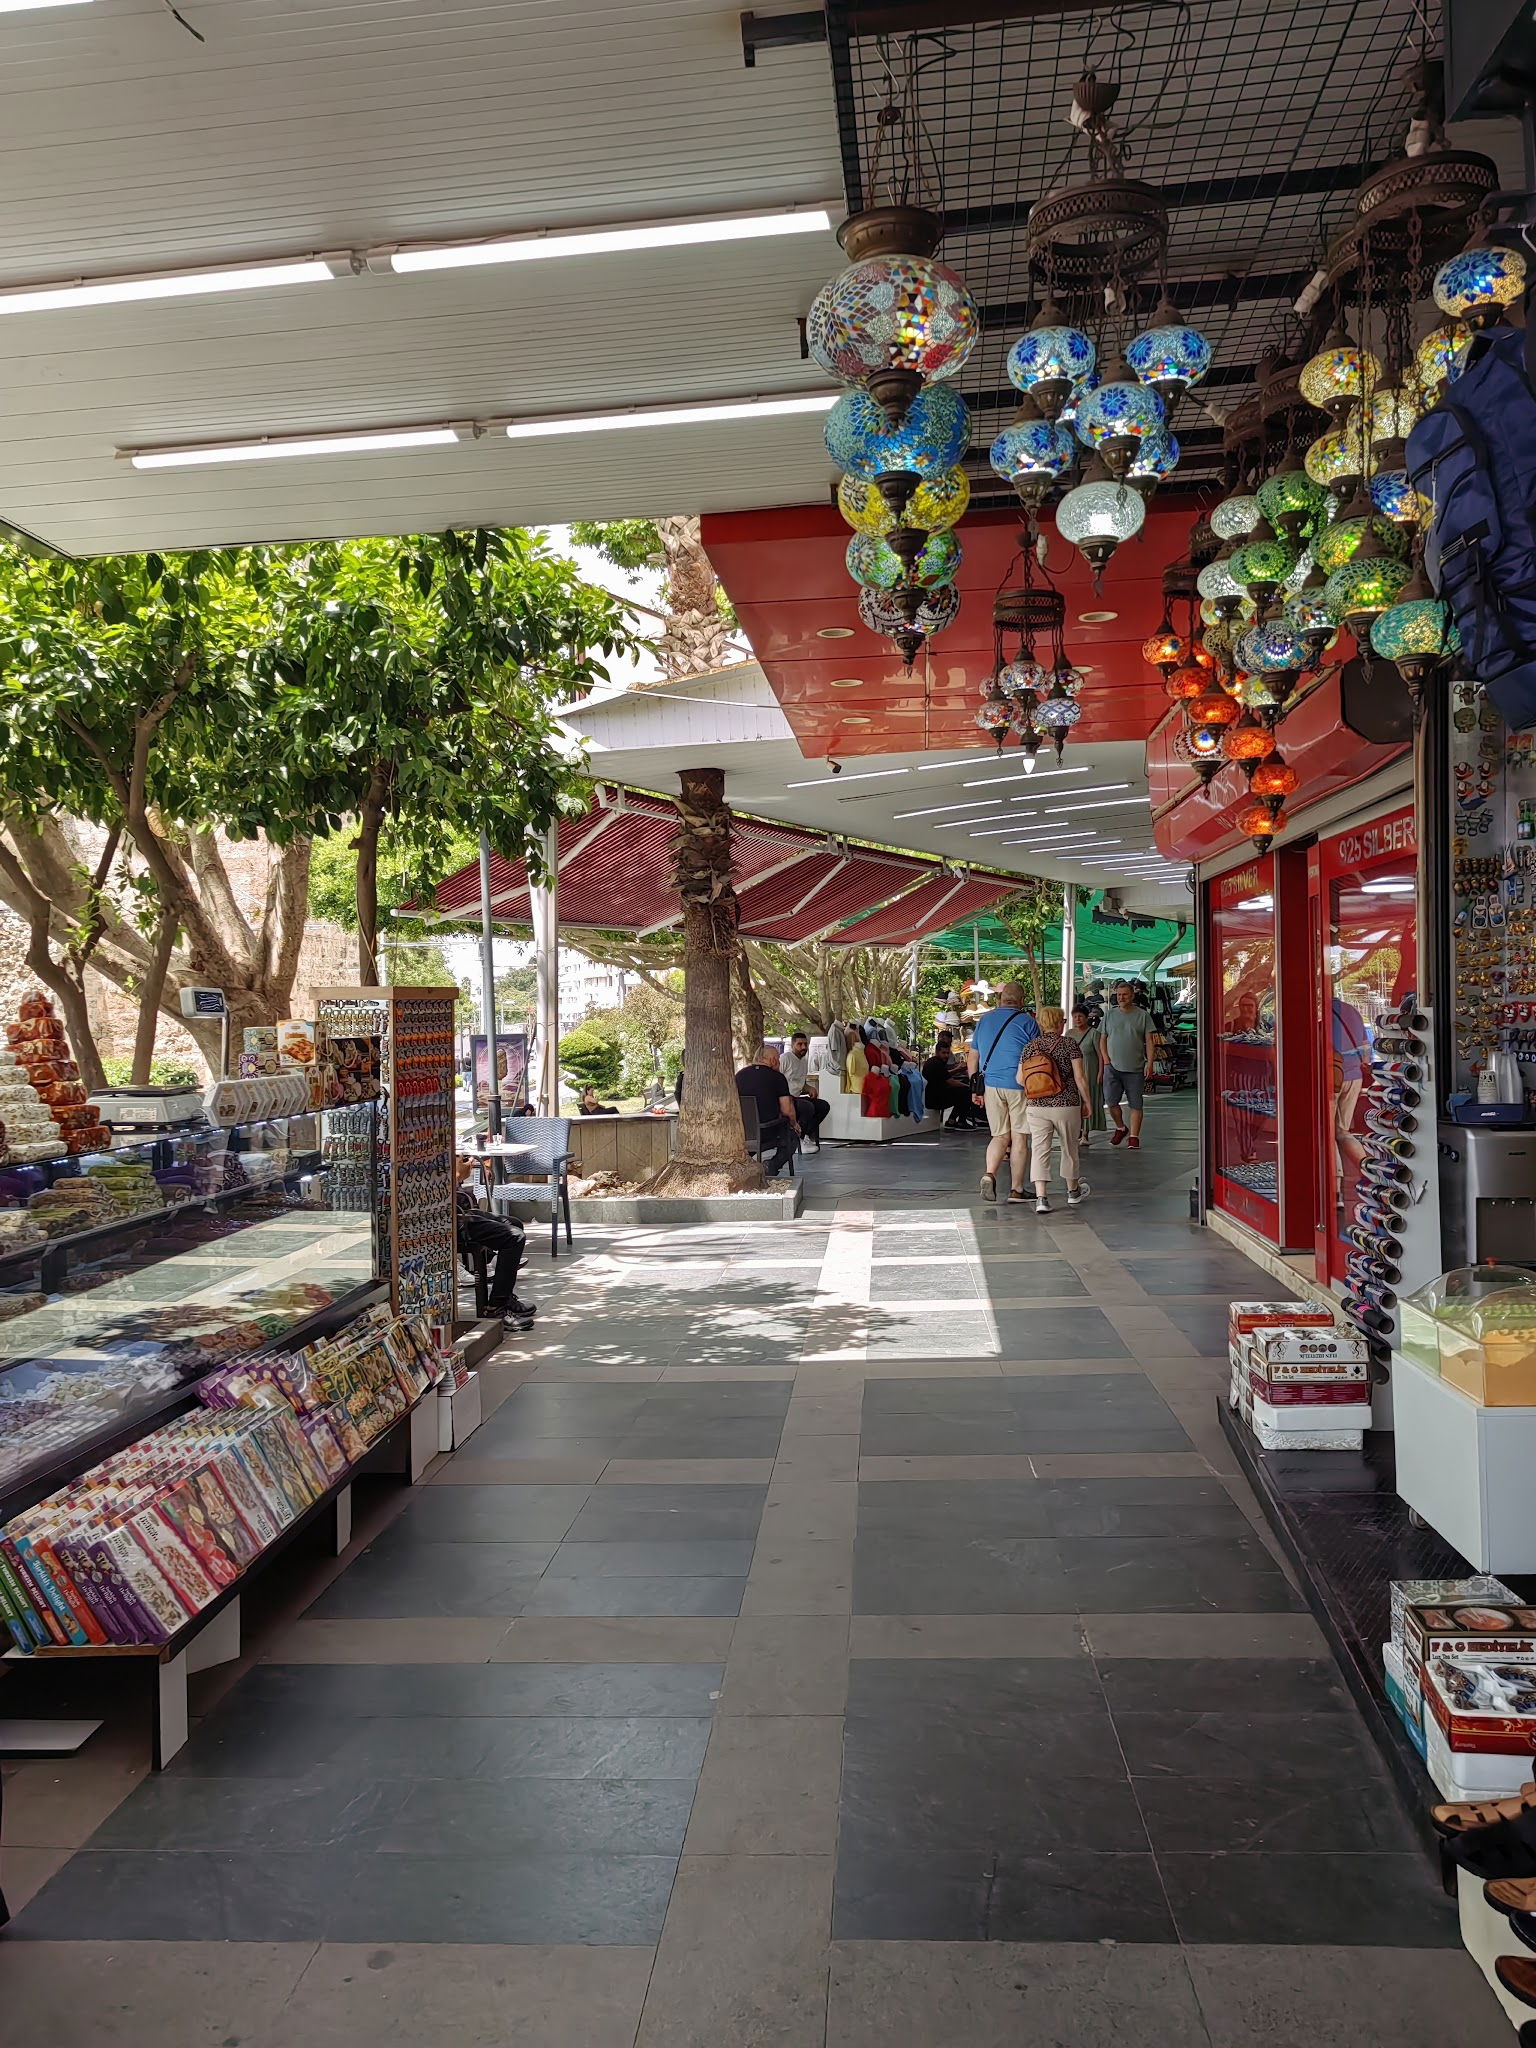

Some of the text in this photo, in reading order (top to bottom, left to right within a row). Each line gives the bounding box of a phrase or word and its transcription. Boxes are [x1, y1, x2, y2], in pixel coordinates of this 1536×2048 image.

[1339, 816, 1416, 864] 925 SILBER
[1431, 1642, 1440, 1652] F
[1442, 1642, 1453, 1652] &
